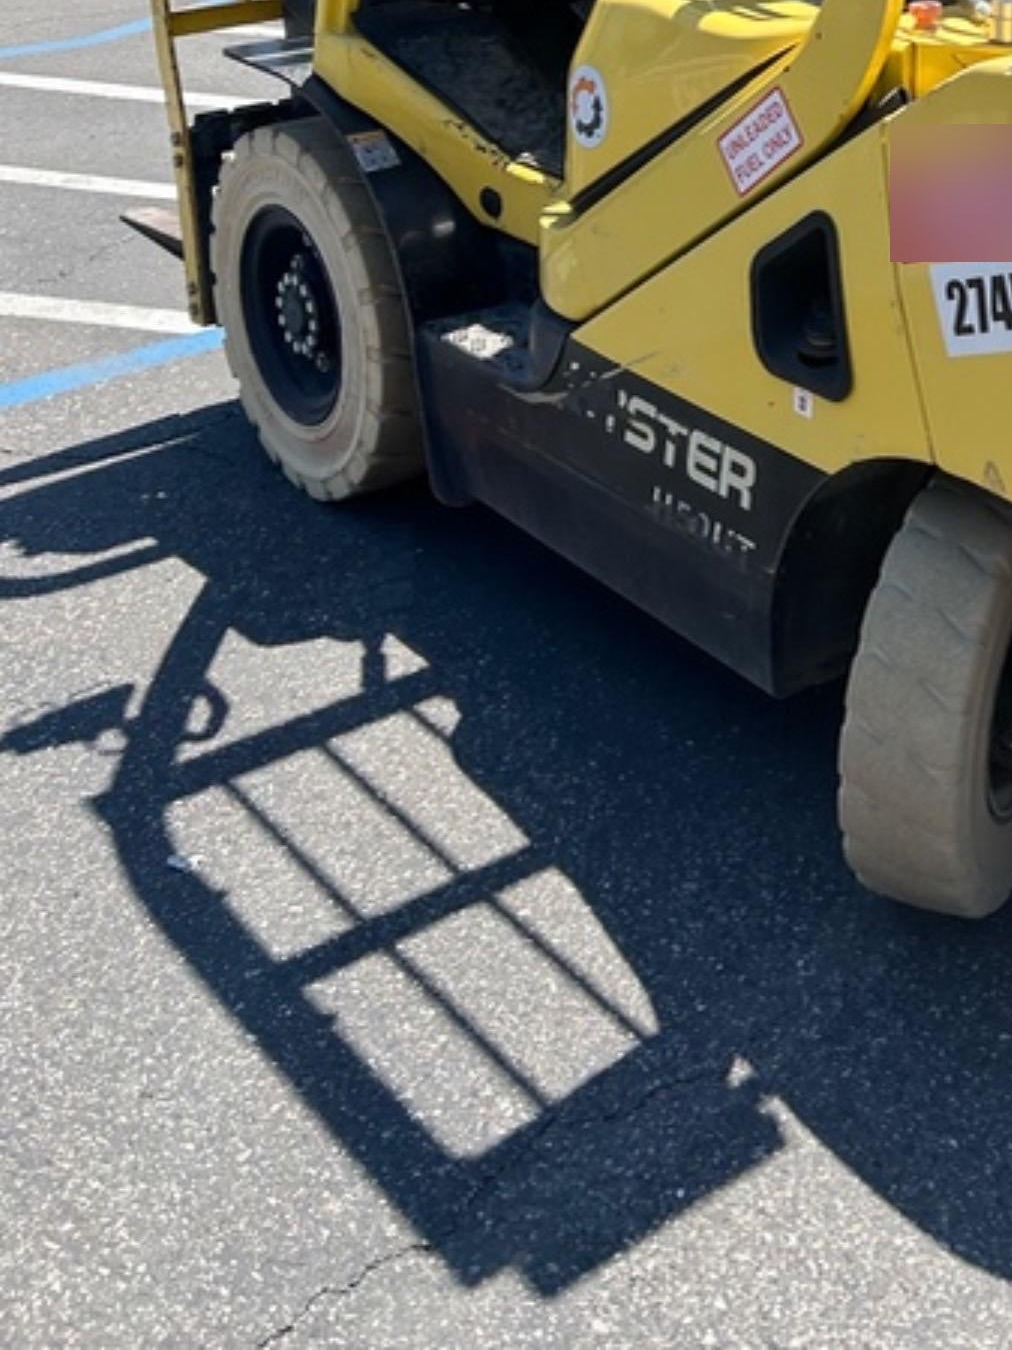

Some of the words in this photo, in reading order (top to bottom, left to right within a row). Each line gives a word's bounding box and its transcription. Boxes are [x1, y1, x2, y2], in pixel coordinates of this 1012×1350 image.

[727, 100, 784, 161] UNLEADED
[734, 156, 765, 184] FUEL
[762, 127, 793, 160] ONLY
[590, 388, 757, 511] STER
